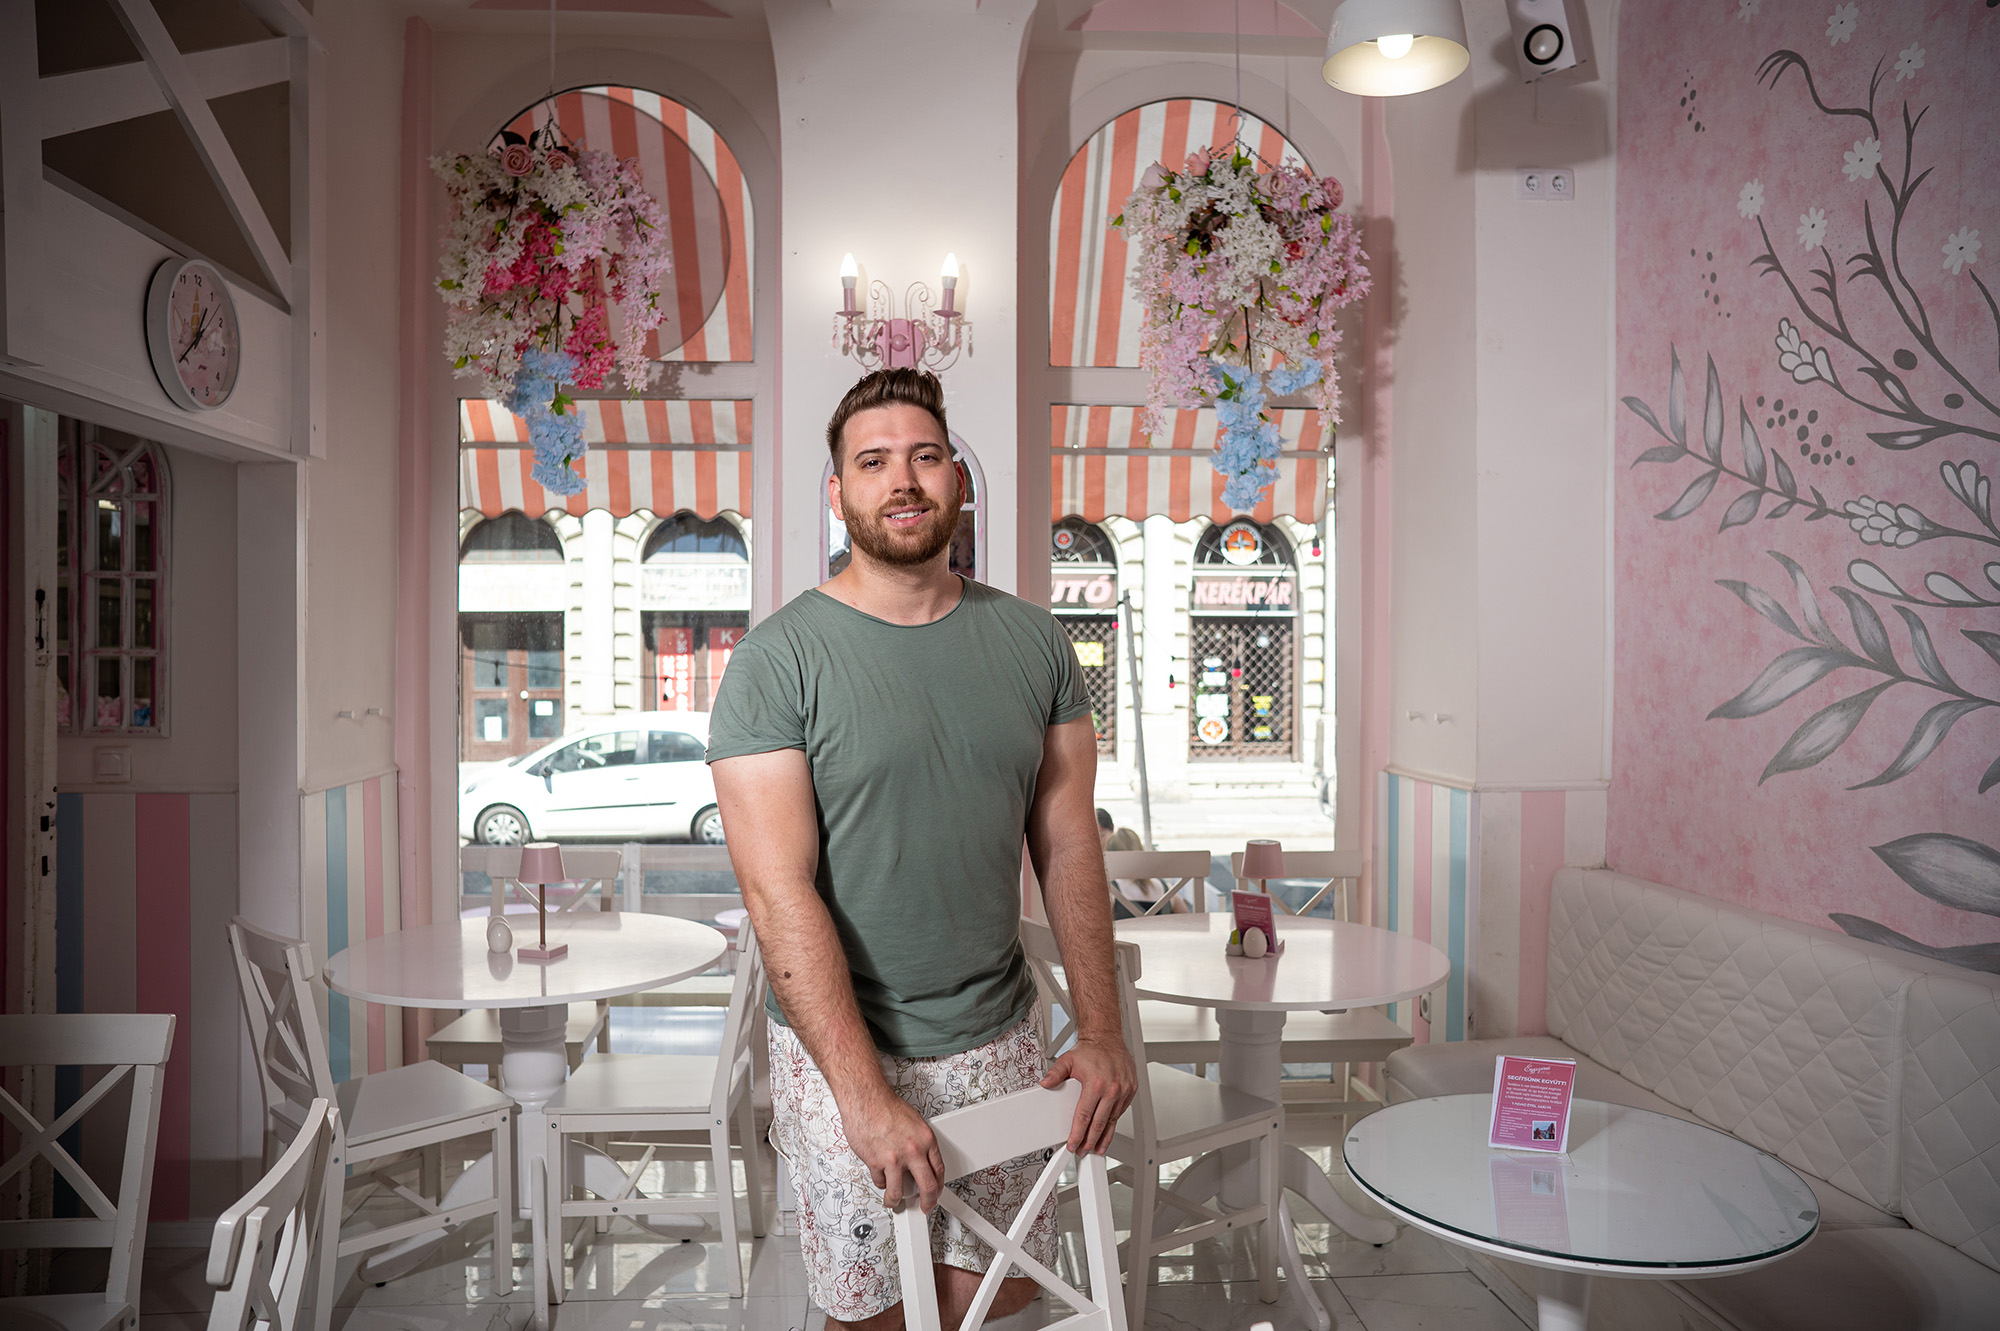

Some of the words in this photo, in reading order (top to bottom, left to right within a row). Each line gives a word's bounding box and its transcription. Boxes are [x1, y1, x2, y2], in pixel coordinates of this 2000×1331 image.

[194, 274, 202, 287] 12
[219, 318, 223, 328] 2
[222, 347, 225, 356] 3
[216, 372, 220, 381] 4
[205, 386, 209, 396] 5
[1193, 576, 1292, 606] KERÉKPÁR
[1507, 1075, 1541, 1083] SEGÍTSÜNK
